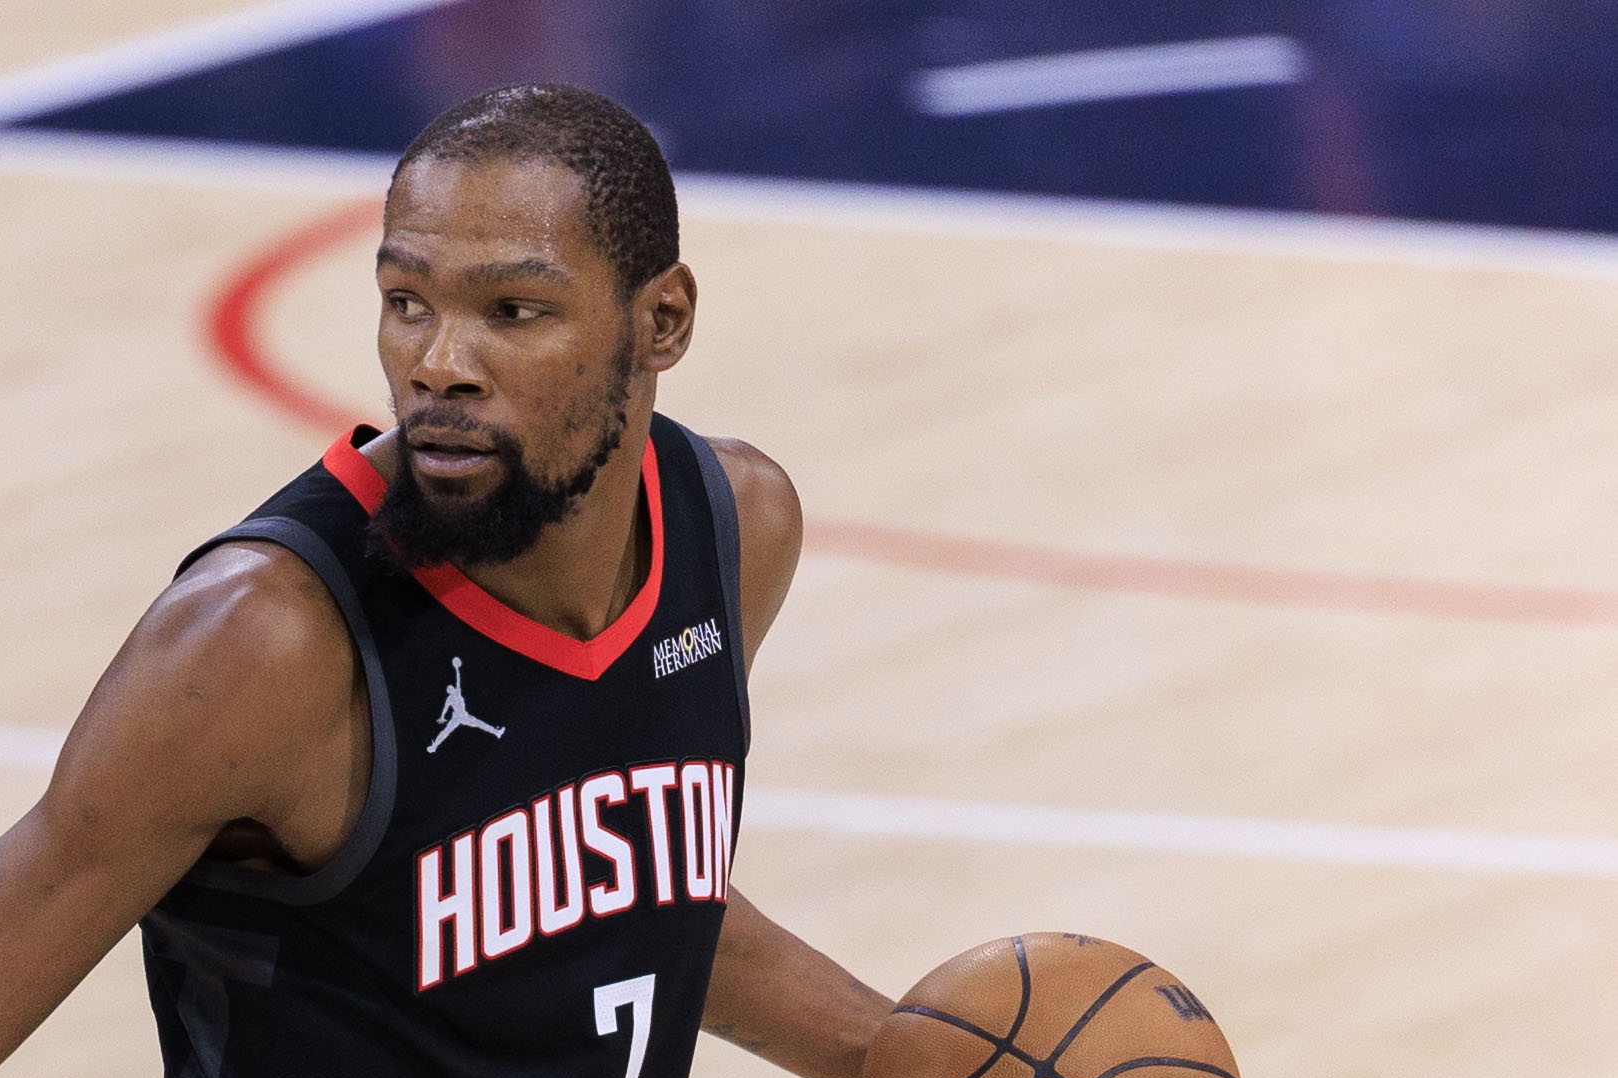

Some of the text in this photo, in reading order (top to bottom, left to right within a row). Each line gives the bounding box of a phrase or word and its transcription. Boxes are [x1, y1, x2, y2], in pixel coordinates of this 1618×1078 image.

[653, 618, 720, 661] MEMORIAL
[654, 635, 722, 678] HERMANN
[418, 760, 735, 992] HOUSTON
